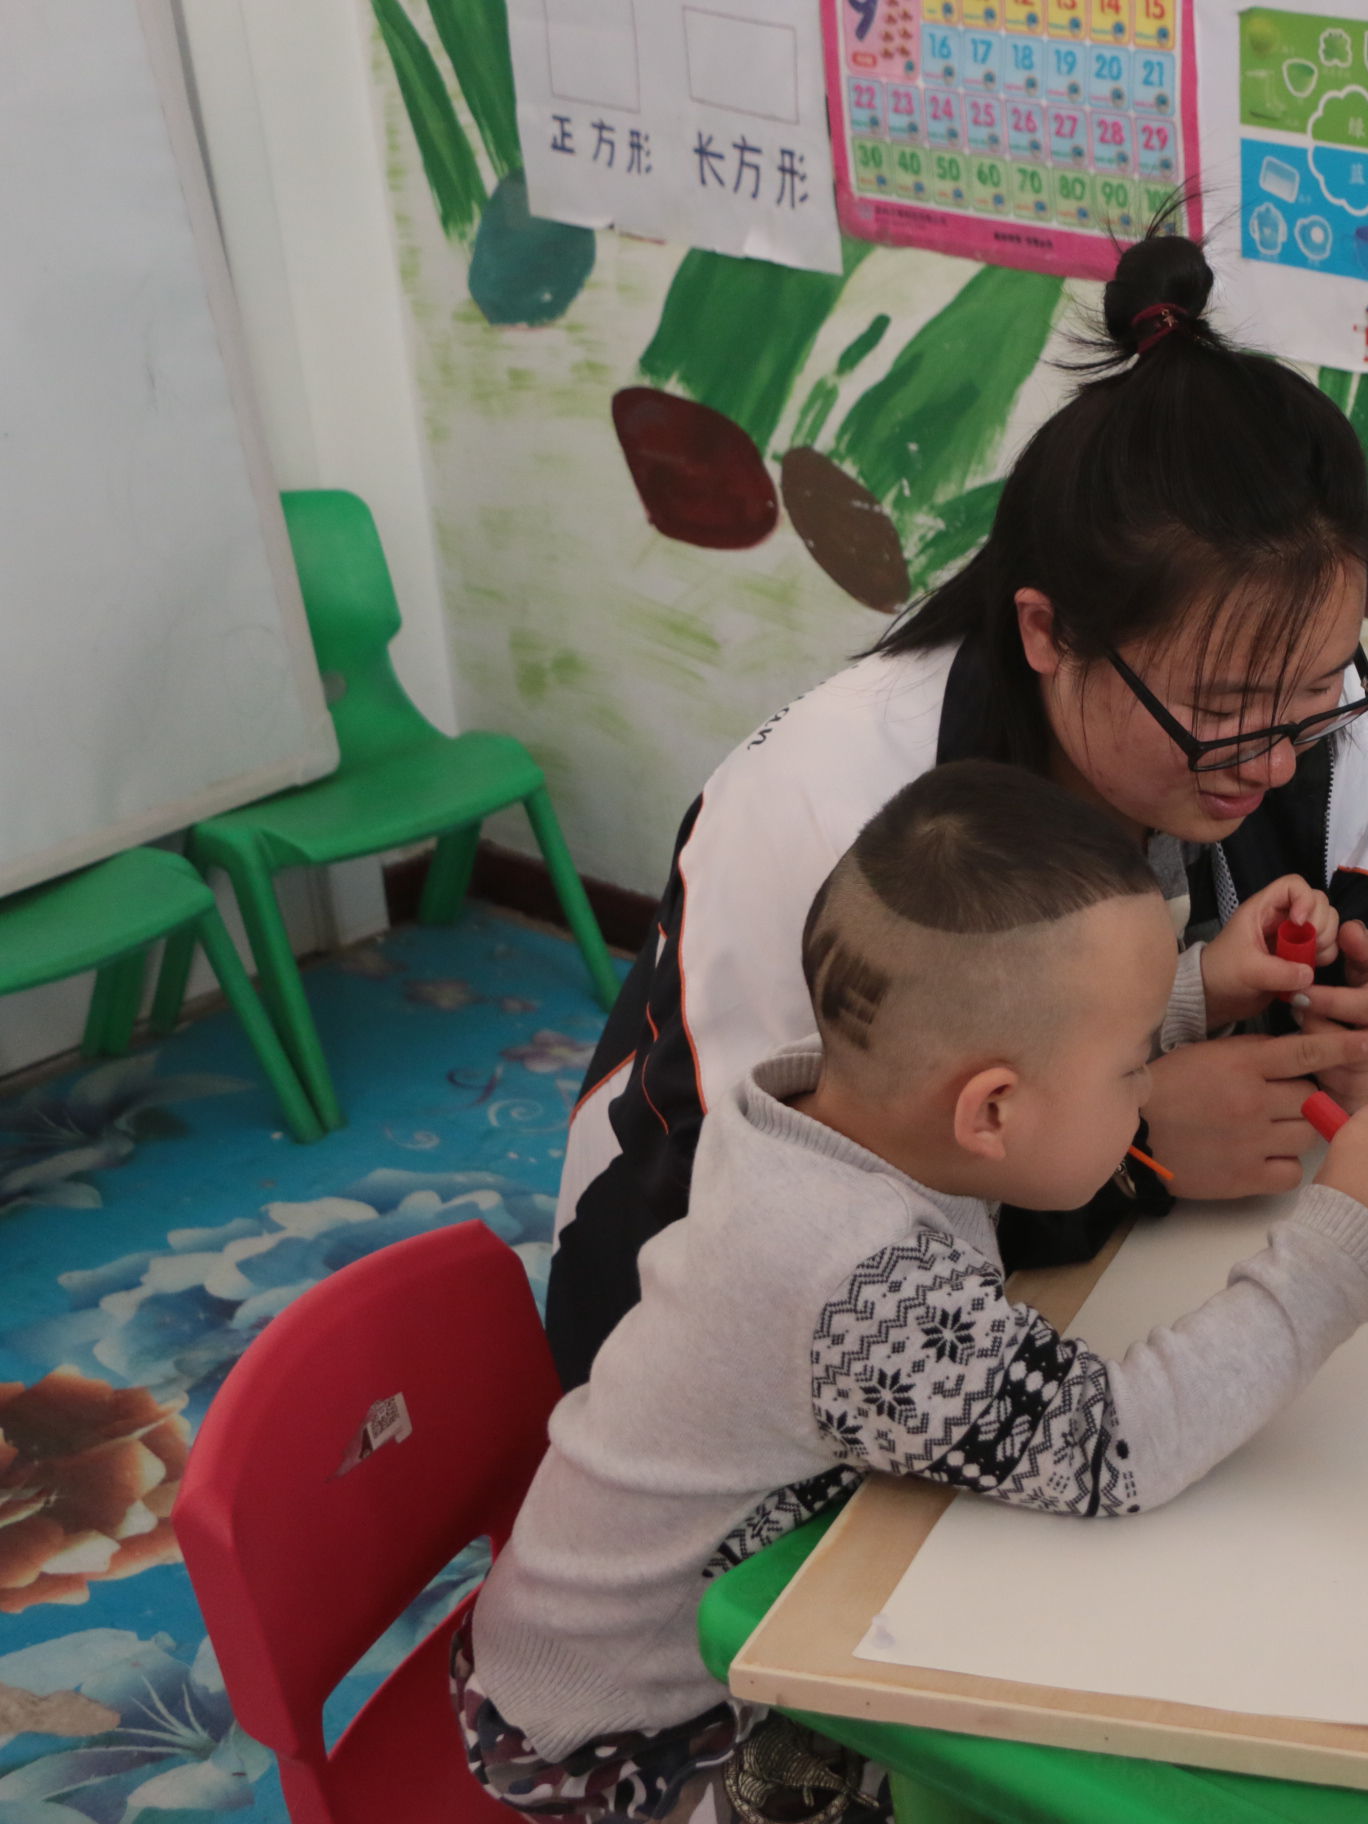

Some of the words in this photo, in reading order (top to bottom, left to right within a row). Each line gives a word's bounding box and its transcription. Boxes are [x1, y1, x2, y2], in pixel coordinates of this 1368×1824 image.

[1144, 0, 1165, 20] 15
[929, 33, 952, 59] 16
[971, 38, 993, 64] 17
[1012, 44, 1034, 70] 18
[1055, 49, 1077, 75] 19
[1095, 54, 1122, 81] 20
[1142, 60, 1165, 87] 21
[854, 84, 876, 109] 22
[892, 89, 914, 115] 23
[930, 95, 954, 120] 24
[970, 101, 996, 127] 25
[1011, 107, 1037, 133] 26
[1053, 112, 1078, 138] 27
[1098, 118, 1125, 145] 28
[1141, 124, 1169, 151] 29
[550, 115, 653, 175] 正方形
[693, 131, 809, 209] 长方形
[858, 144, 883, 168] 30
[898, 151, 921, 175] 40
[937, 156, 960, 181] 50
[977, 162, 1000, 187] 60
[1017, 167, 1042, 194] 70
[1058, 174, 1085, 201] 80
[1102, 181, 1128, 208] 90
